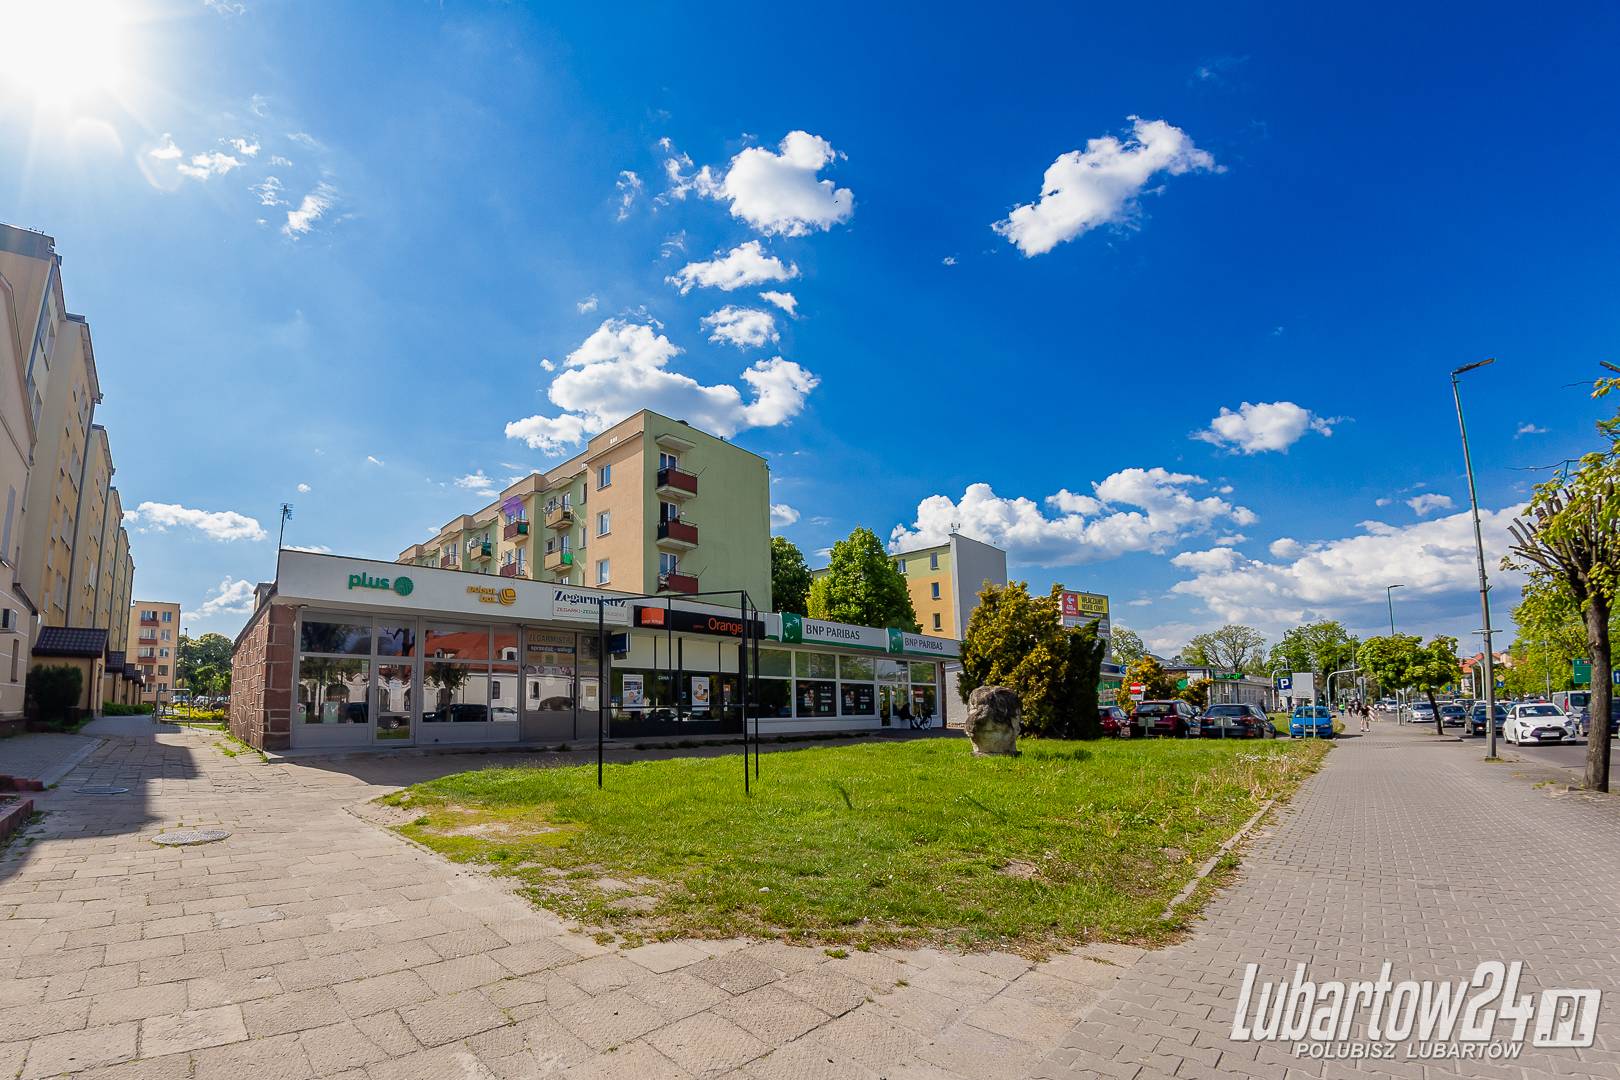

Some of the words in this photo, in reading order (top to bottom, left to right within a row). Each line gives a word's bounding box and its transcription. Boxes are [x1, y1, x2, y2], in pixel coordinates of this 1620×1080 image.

[348, 572, 390, 590] plus
[708, 617, 743, 635] Orange
[805, 624, 825, 635] BNP
[826, 627, 860, 640] PARIBAS
[904, 637, 918, 648] BNP
[918, 639, 943, 650] PARIBAS
[1280, 678, 1289, 689] P
